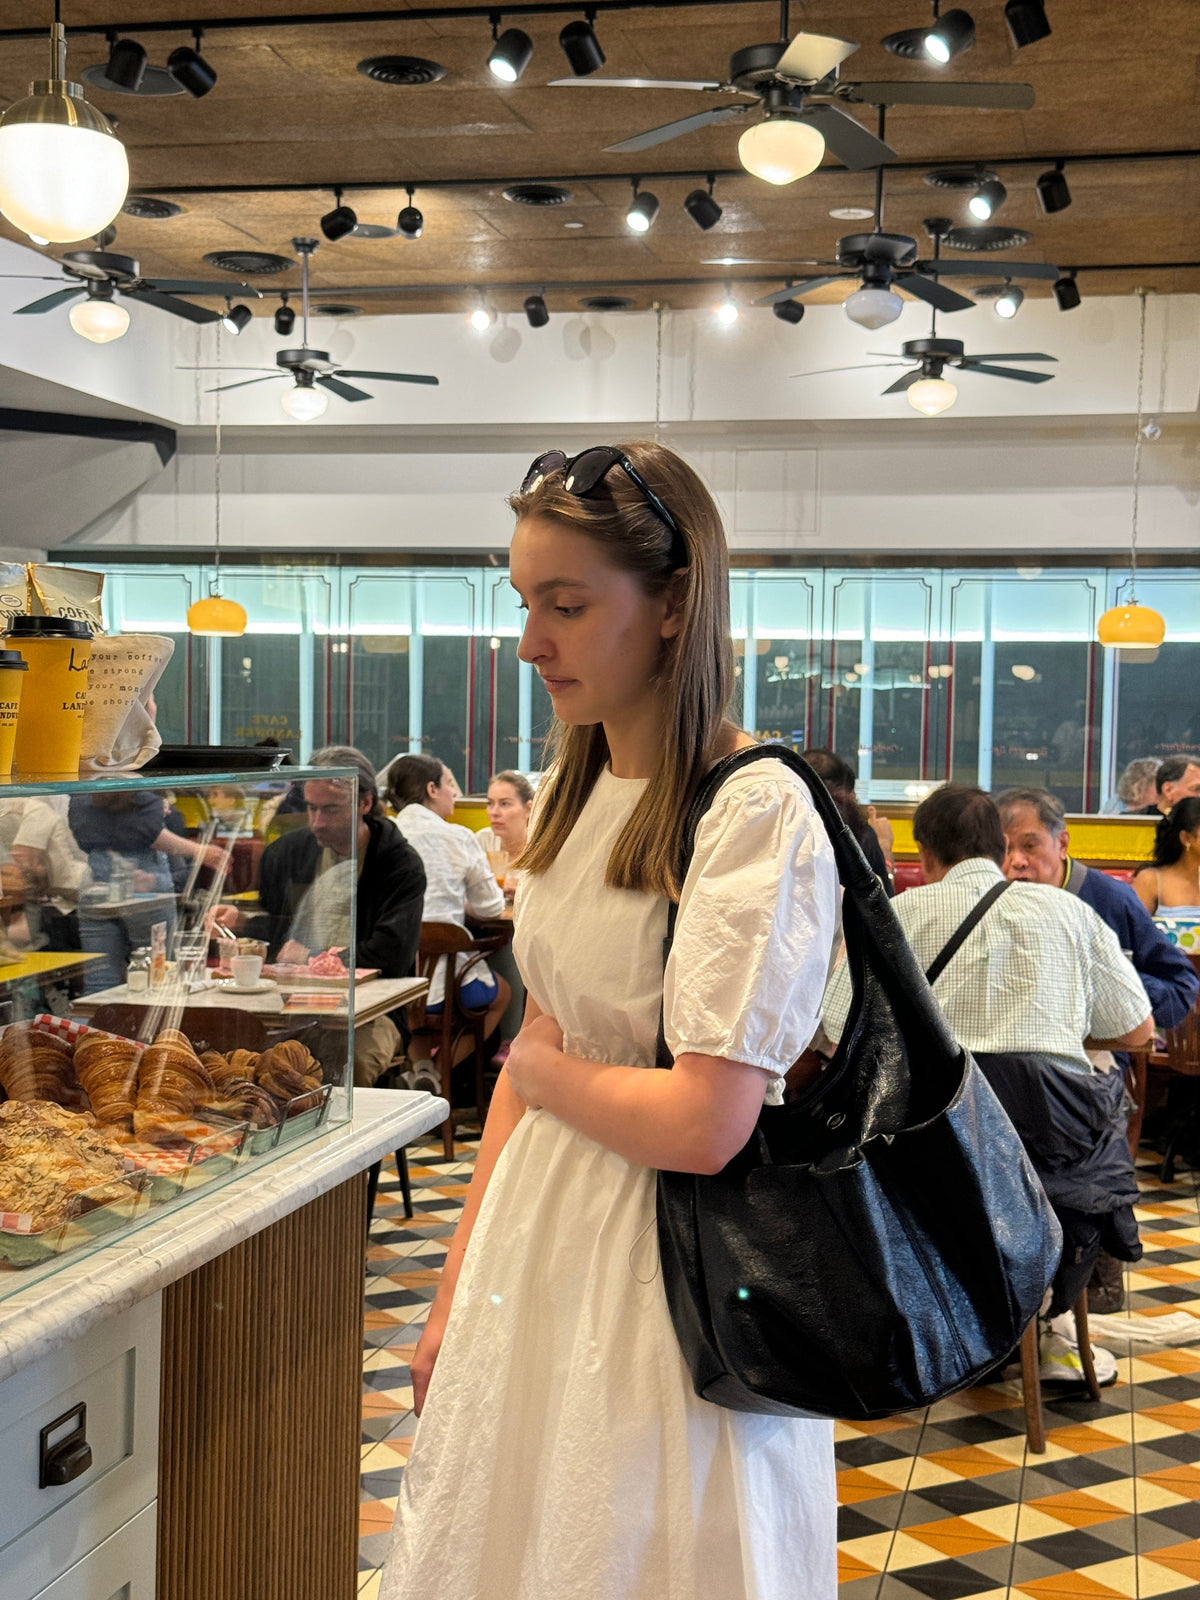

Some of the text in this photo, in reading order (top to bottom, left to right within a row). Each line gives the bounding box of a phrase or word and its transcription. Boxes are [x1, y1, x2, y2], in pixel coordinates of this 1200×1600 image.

[68, 648, 91, 672] La
[91, 653, 119, 661] your
[103, 668, 144, 676] strong
[87, 683, 114, 691] your
[75, 692, 87, 700] CA
[62, 702, 85, 711] LAN
